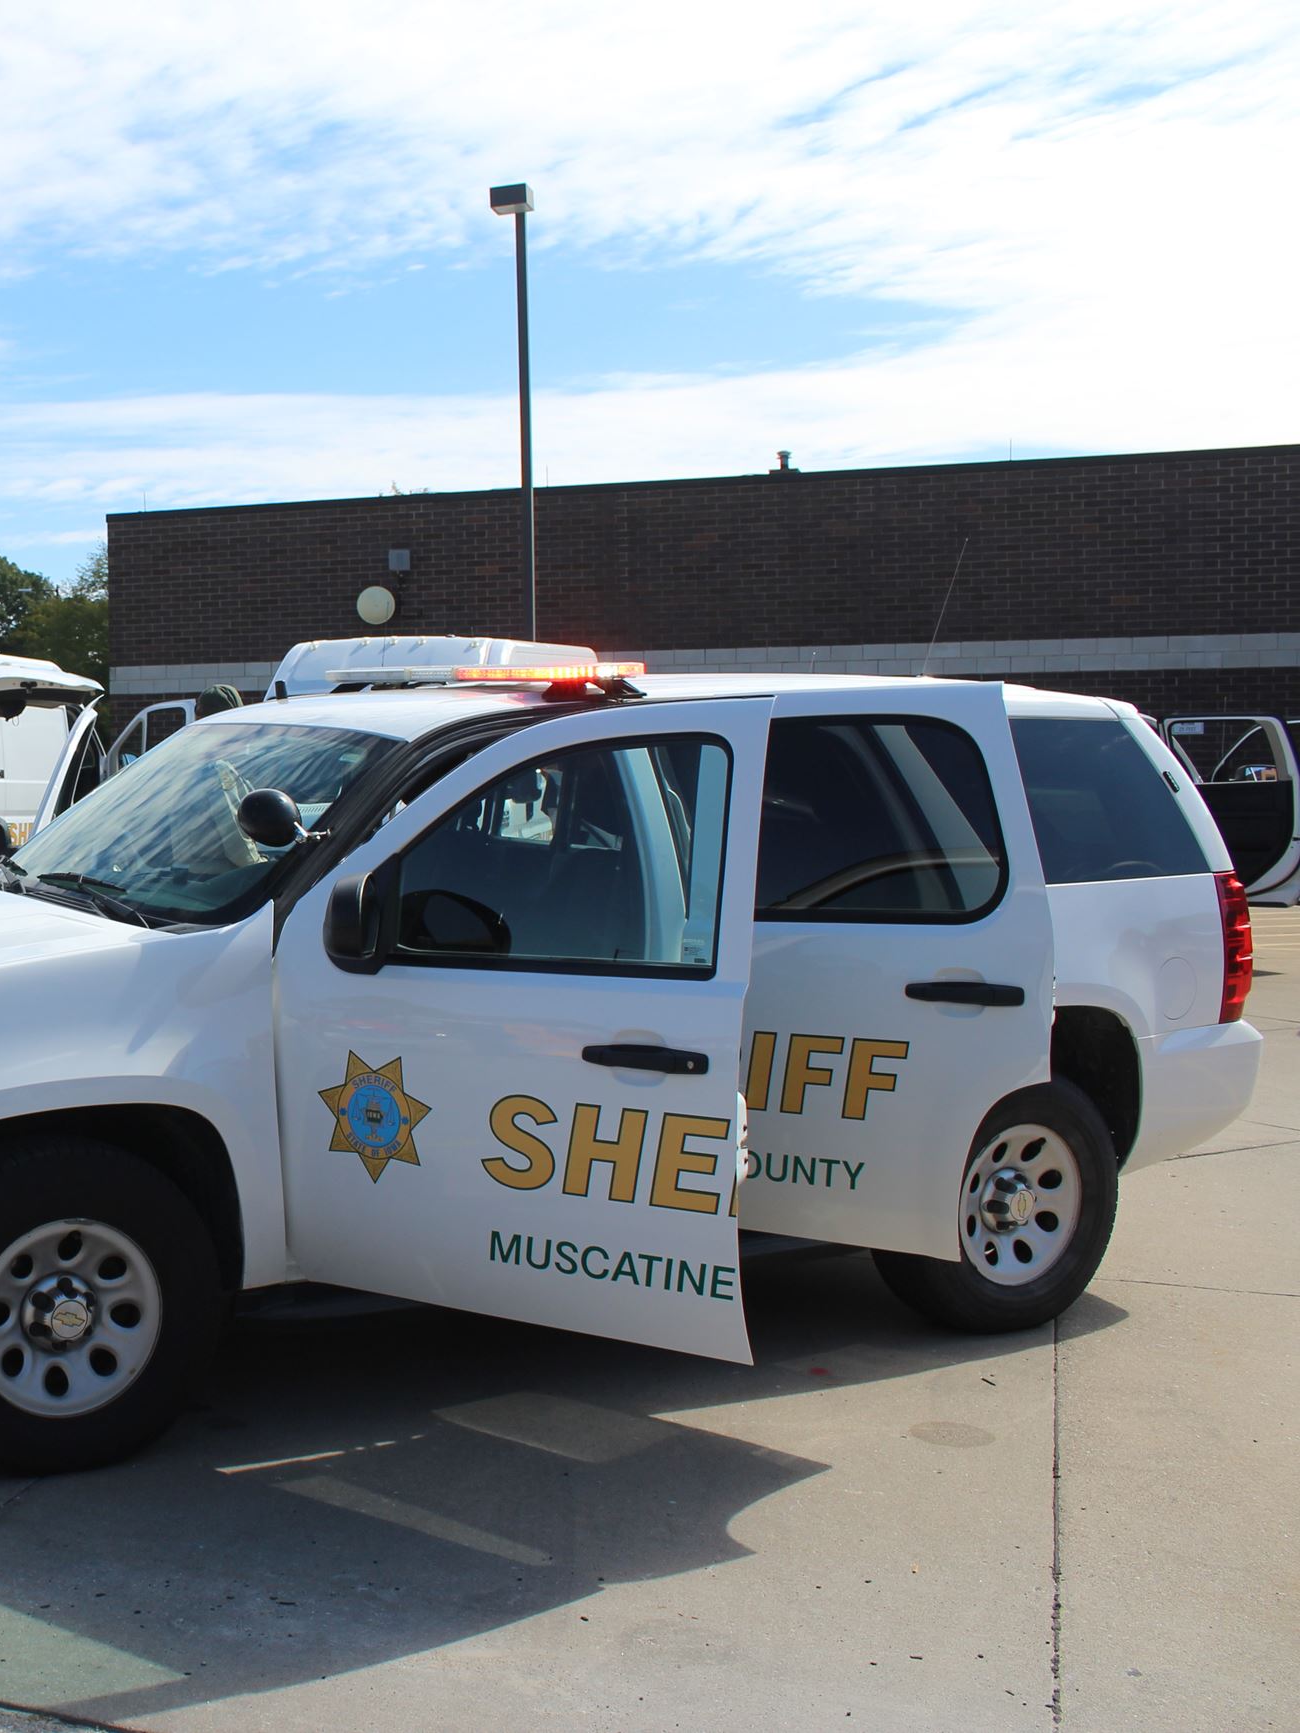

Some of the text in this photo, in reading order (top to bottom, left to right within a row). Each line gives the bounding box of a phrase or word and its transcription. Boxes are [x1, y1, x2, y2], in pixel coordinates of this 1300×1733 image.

[351, 1074, 397, 1092] SHERIFF
[745, 1030, 910, 1121] IFF
[347, 1131, 402, 1157] STATE OF IOWA
[481, 1094, 738, 1218] SHE
[489, 1230, 736, 1301] MUSCATINE
